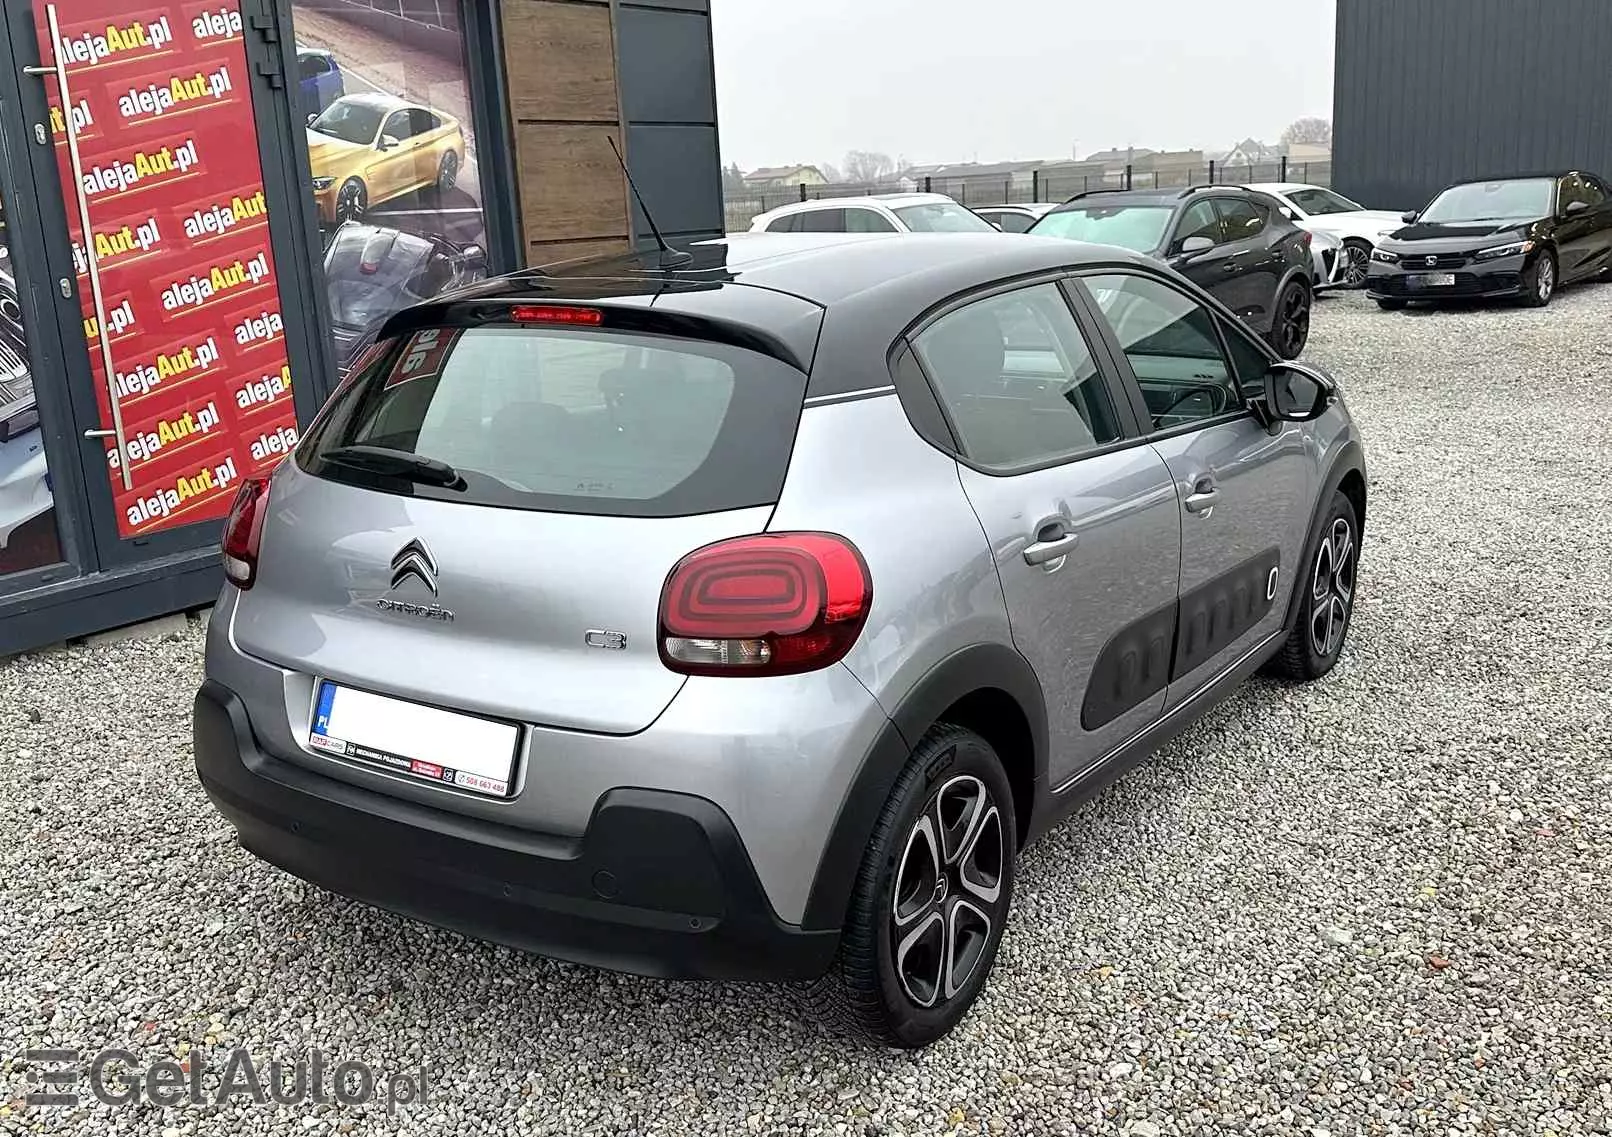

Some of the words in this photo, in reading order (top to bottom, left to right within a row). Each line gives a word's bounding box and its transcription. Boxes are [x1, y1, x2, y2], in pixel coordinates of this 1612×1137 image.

[118, 66, 232, 117] alejaAut.pl
[82, 139, 199, 195] alejaAut.pl
[161, 252, 270, 310] alejaAut.pl
[234, 311, 284, 345] aleja
[106, 402, 220, 469] aejaAut.pl
[250, 427, 299, 461] aleja
[127, 456, 237, 526] alejaAut.pl
[584, 628, 628, 650] C3
